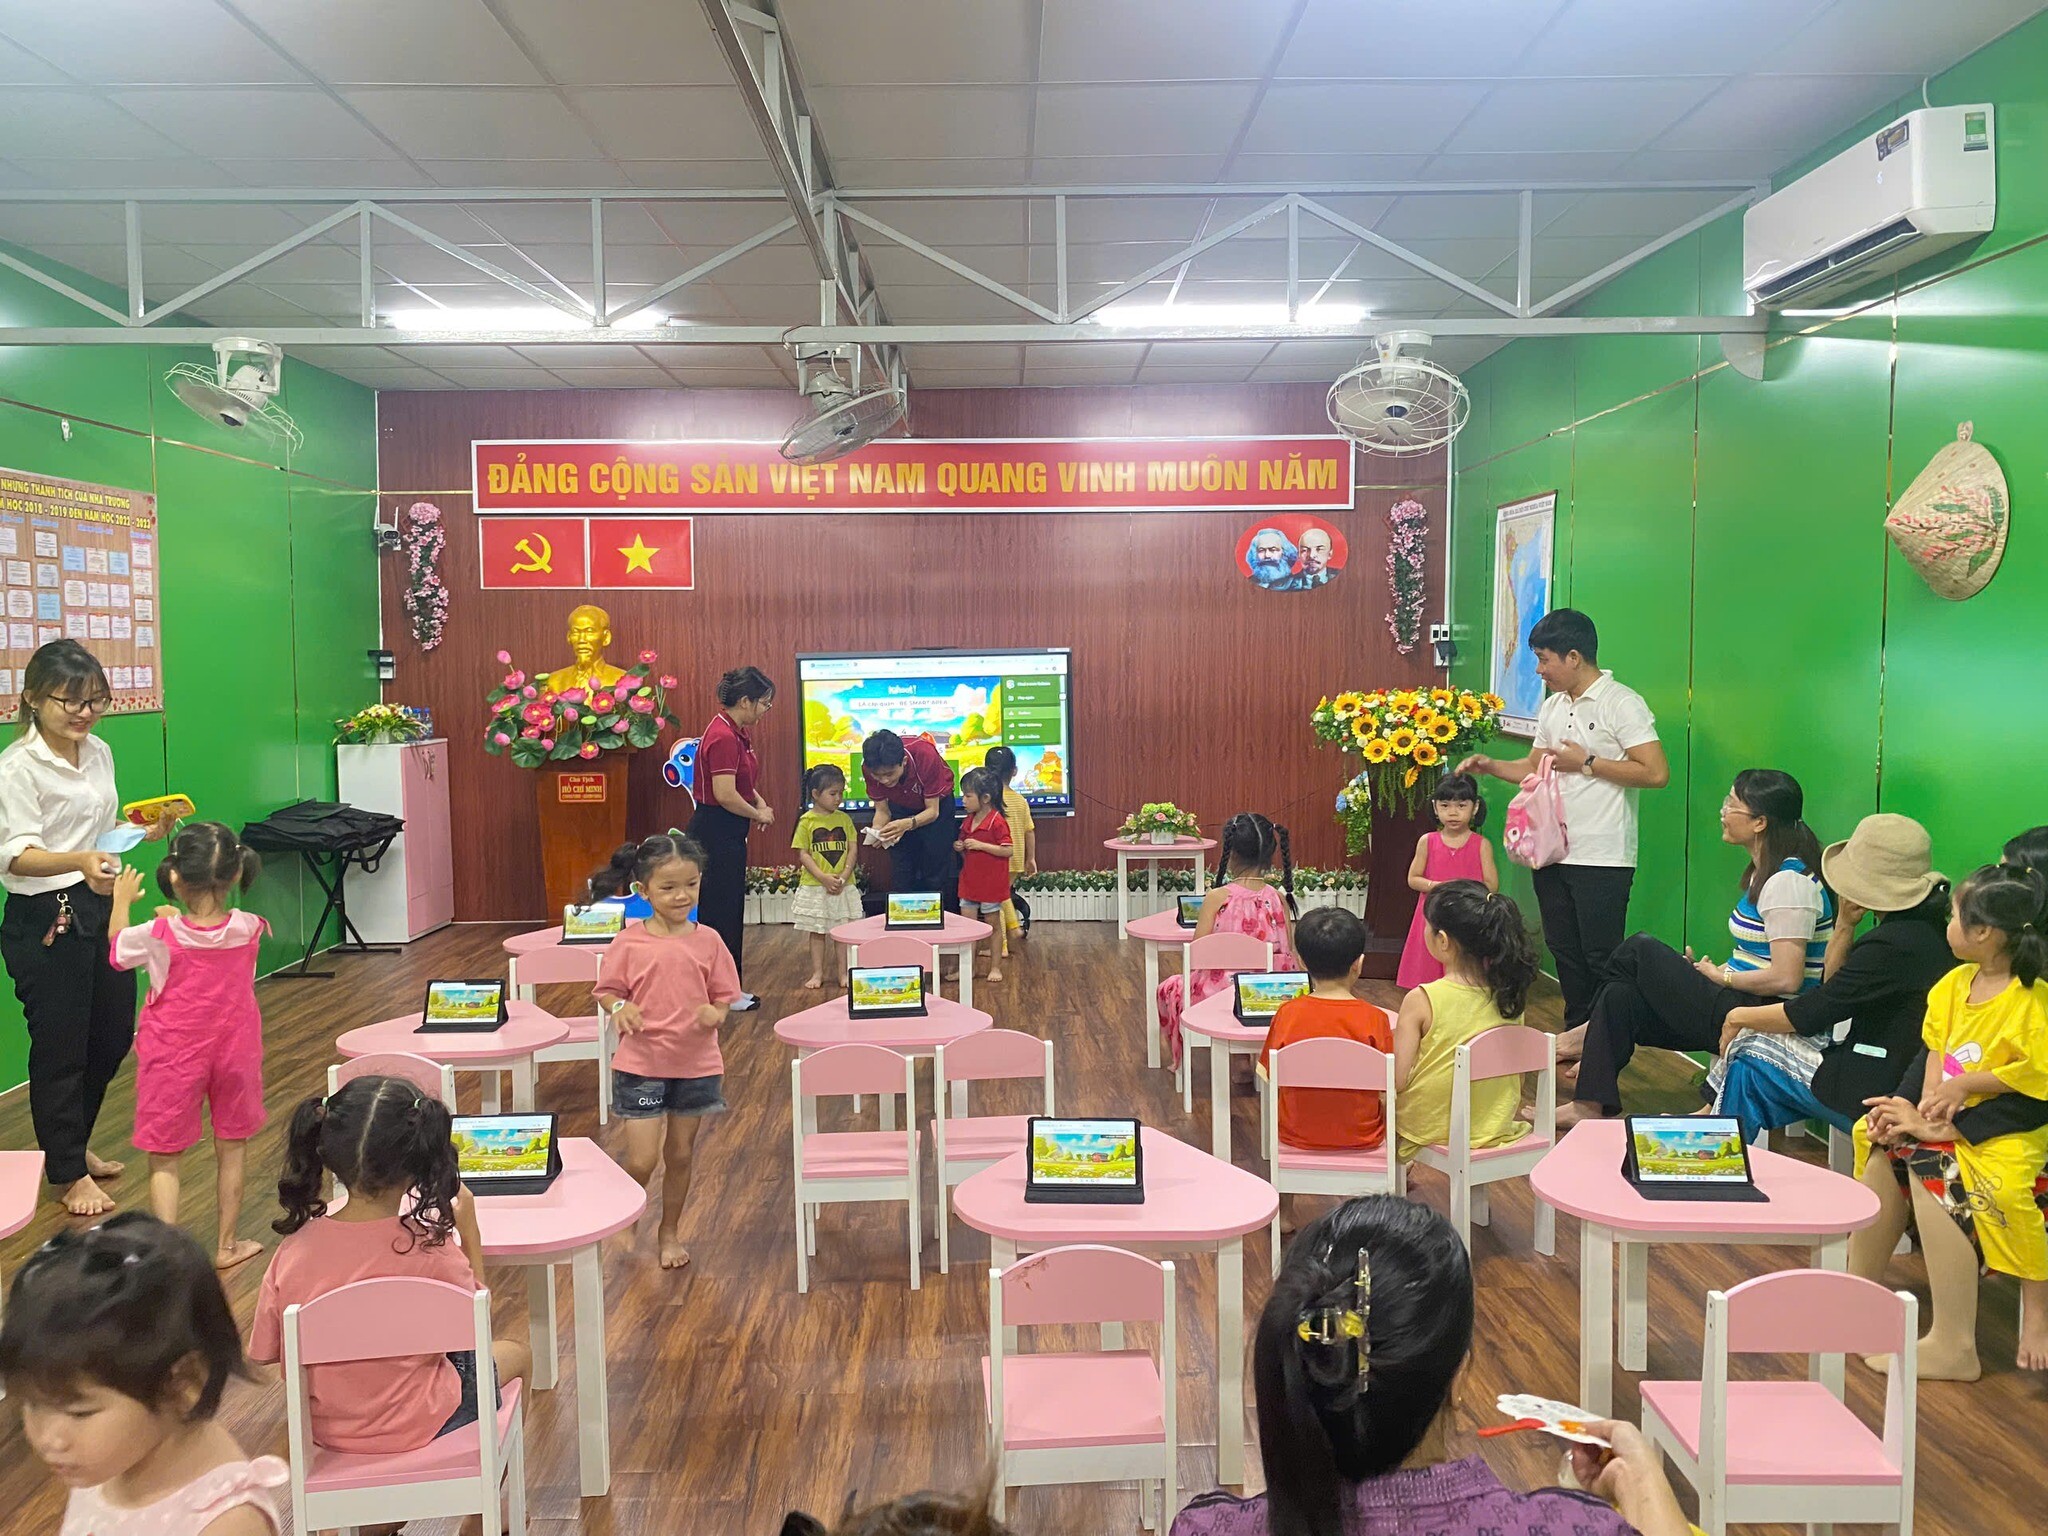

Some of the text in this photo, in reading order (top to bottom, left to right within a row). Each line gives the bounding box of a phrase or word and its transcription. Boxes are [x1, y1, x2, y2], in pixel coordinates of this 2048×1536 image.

[488, 452, 1338, 501] ĐẢNG CỘNG SẢN VIỆT NAM QUANG VINH MUÔN NĂM
[25, 500, 43, 514] 2018
[50, 504, 67, 517] 2019
[572, 784, 585, 793] CHÍ
[585, 785, 602, 793] MINH
